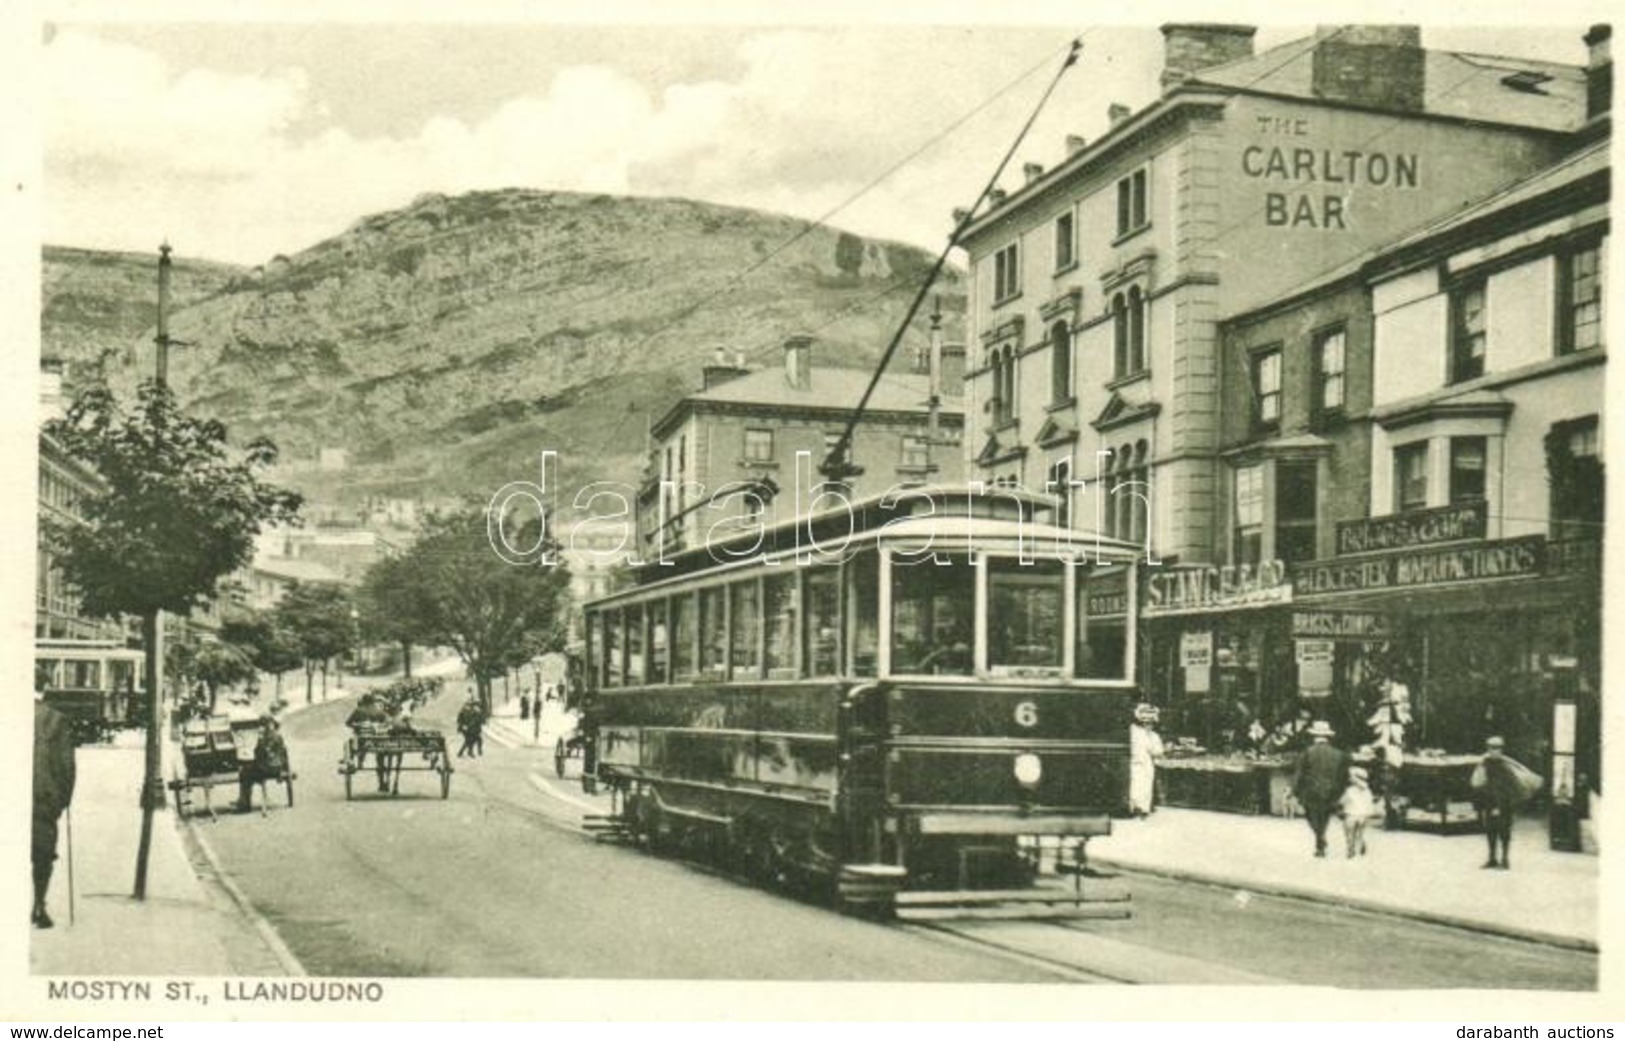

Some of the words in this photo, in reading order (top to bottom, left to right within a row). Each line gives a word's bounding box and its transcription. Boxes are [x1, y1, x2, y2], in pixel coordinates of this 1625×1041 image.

[1257, 116, 1308, 135] THE
[1242, 146, 1418, 187] CARLTON
[1266, 193, 1345, 229] BAR
[1015, 702, 1038, 727] 6
